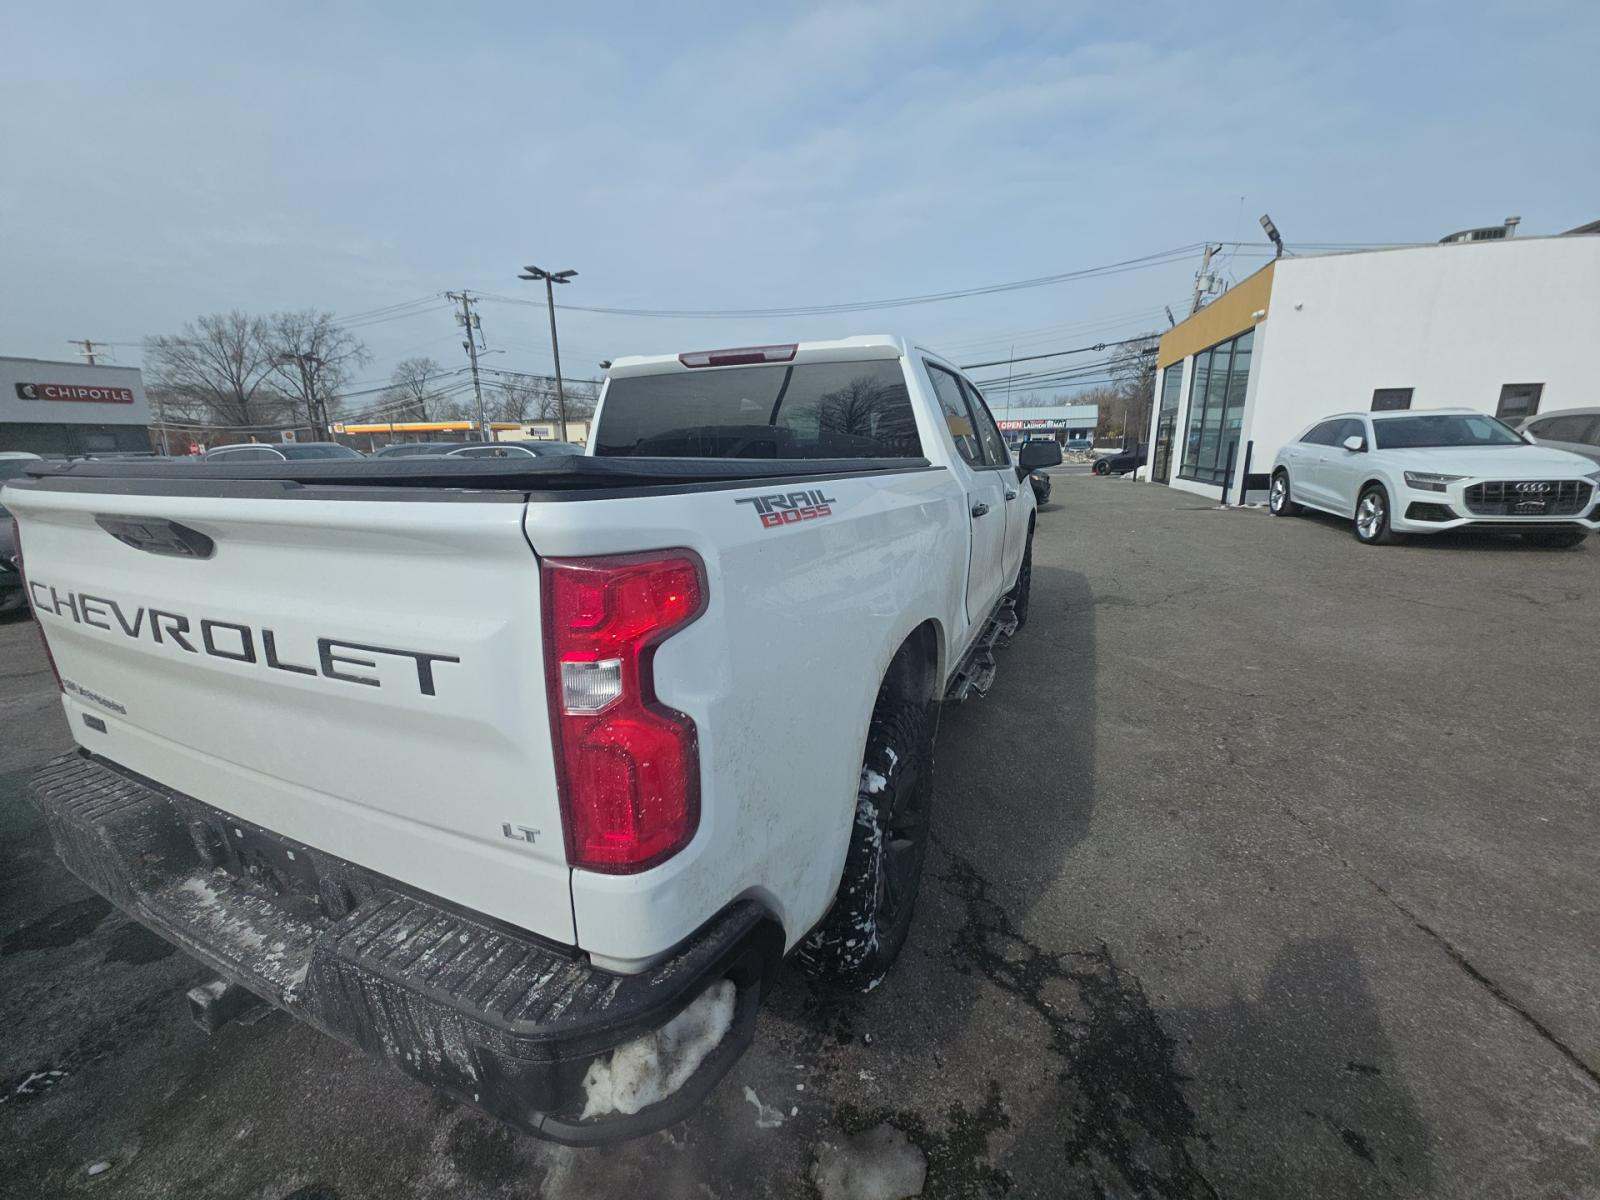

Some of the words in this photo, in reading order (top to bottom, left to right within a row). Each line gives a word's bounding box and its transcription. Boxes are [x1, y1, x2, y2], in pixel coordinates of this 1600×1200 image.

[45, 386, 132, 401] CHIPOTLE
[1001, 421, 1022, 430] OPEN
[734, 489, 837, 514] TRAIL
[760, 503, 833, 528] BOSS
[29, 580, 461, 696] CHEVROLET
[502, 822, 541, 844] LT
